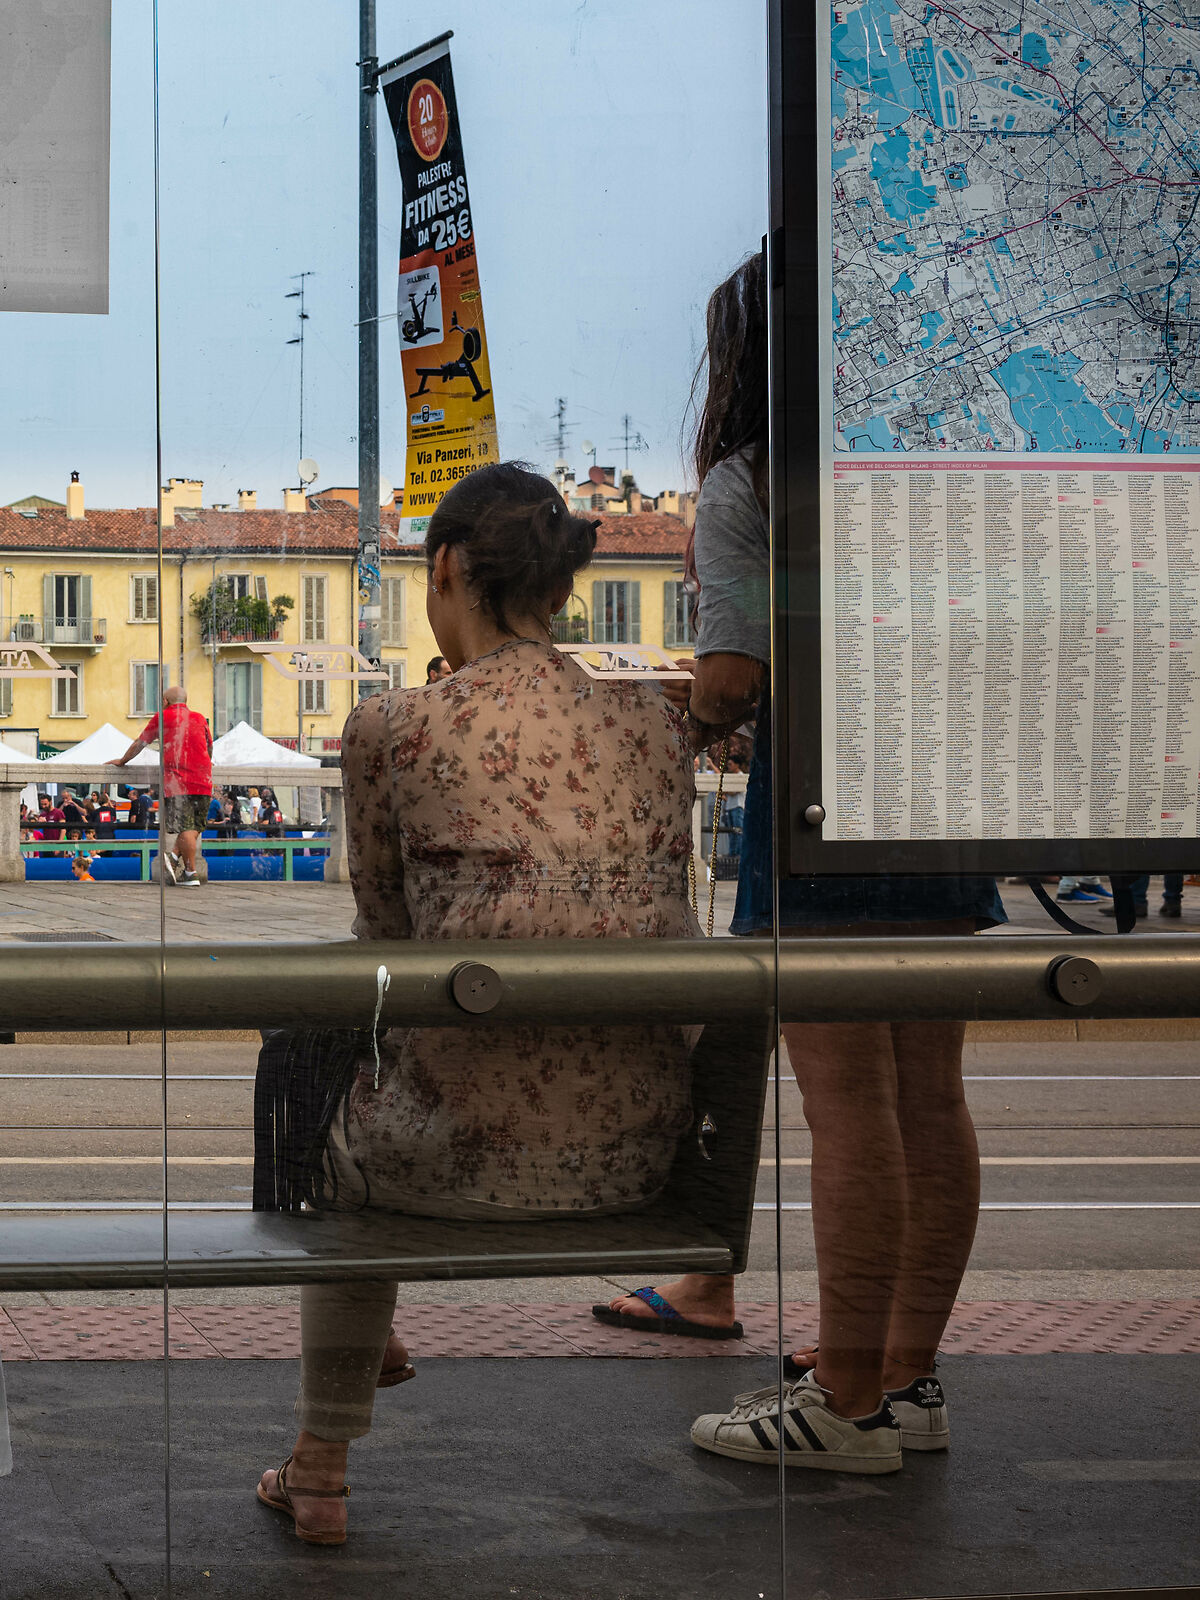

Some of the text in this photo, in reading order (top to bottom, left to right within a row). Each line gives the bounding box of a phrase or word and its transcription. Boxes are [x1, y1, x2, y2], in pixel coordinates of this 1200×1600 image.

[419, 94, 433, 125] 20
[418, 161, 452, 188] PALESTRE
[405, 175, 467, 229] FITNESS
[418, 209, 471, 252] DA 25€
[445, 243, 475, 266] AL MESE
[417, 451, 432, 465] Via
[436, 444, 475, 462] Panzeri,
[410, 472, 427, 486] Tel.
